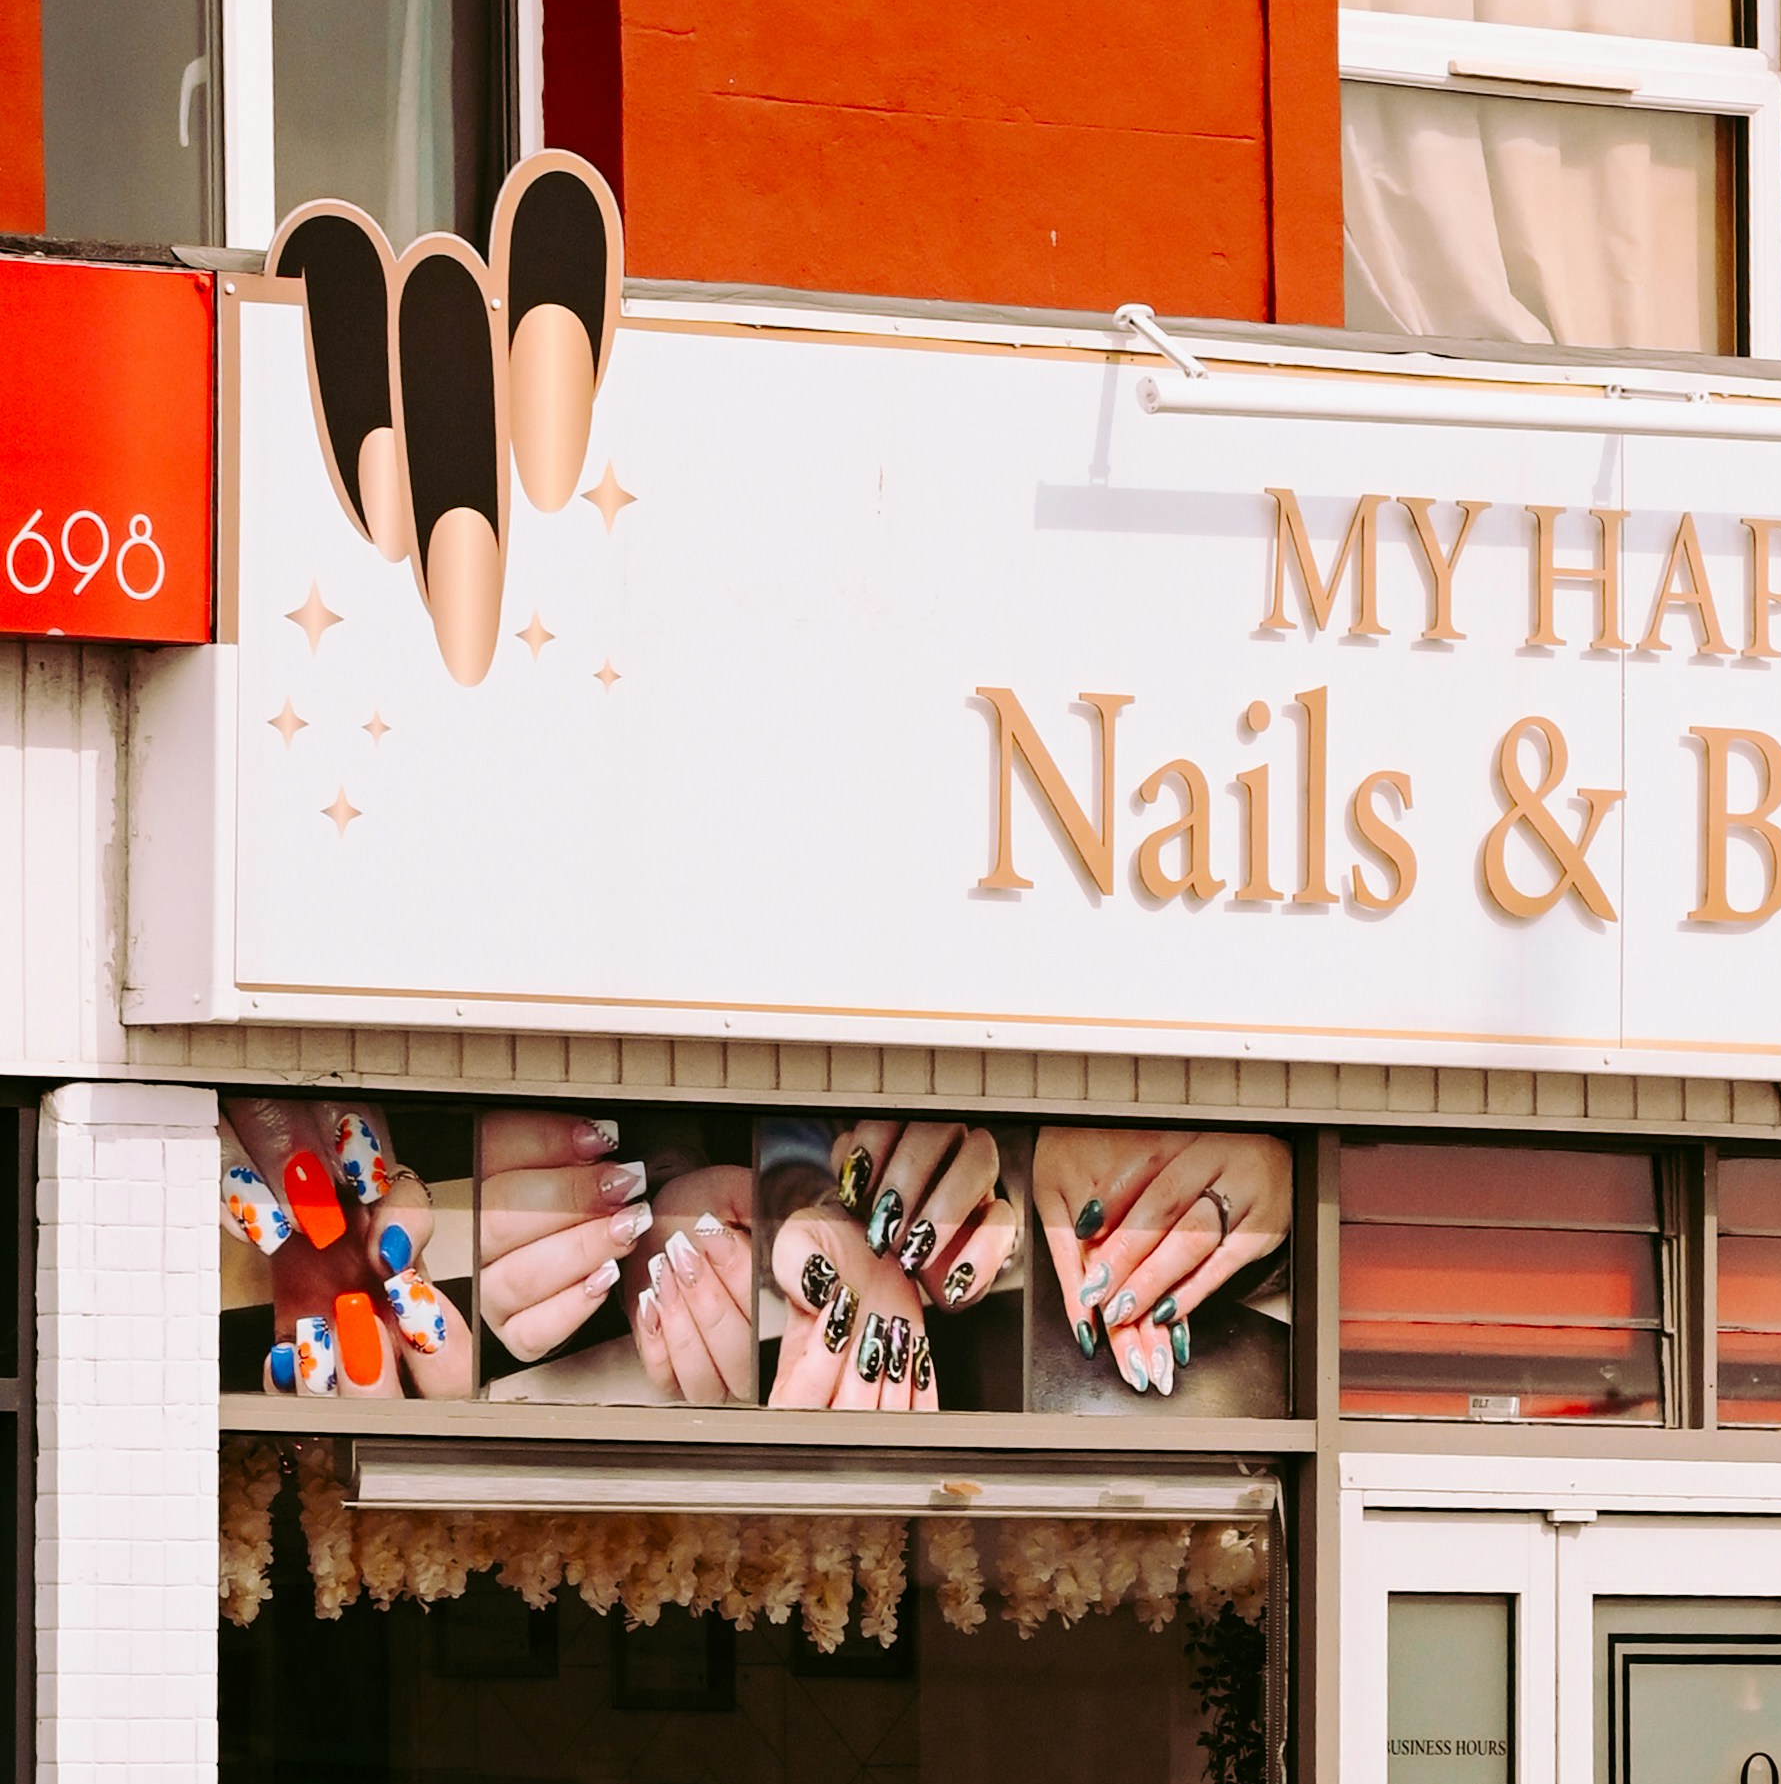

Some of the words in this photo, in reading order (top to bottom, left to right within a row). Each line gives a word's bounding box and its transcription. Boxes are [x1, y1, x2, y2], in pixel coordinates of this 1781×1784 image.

[5, 508, 166, 601] 698
[1262, 487, 1492, 641] MY
[975, 685, 1418, 911] Nails
[1483, 715, 1627, 923] &
[1387, 1739, 1451, 1755] USINESS
[1456, 1740, 1507, 1755] HOURS
